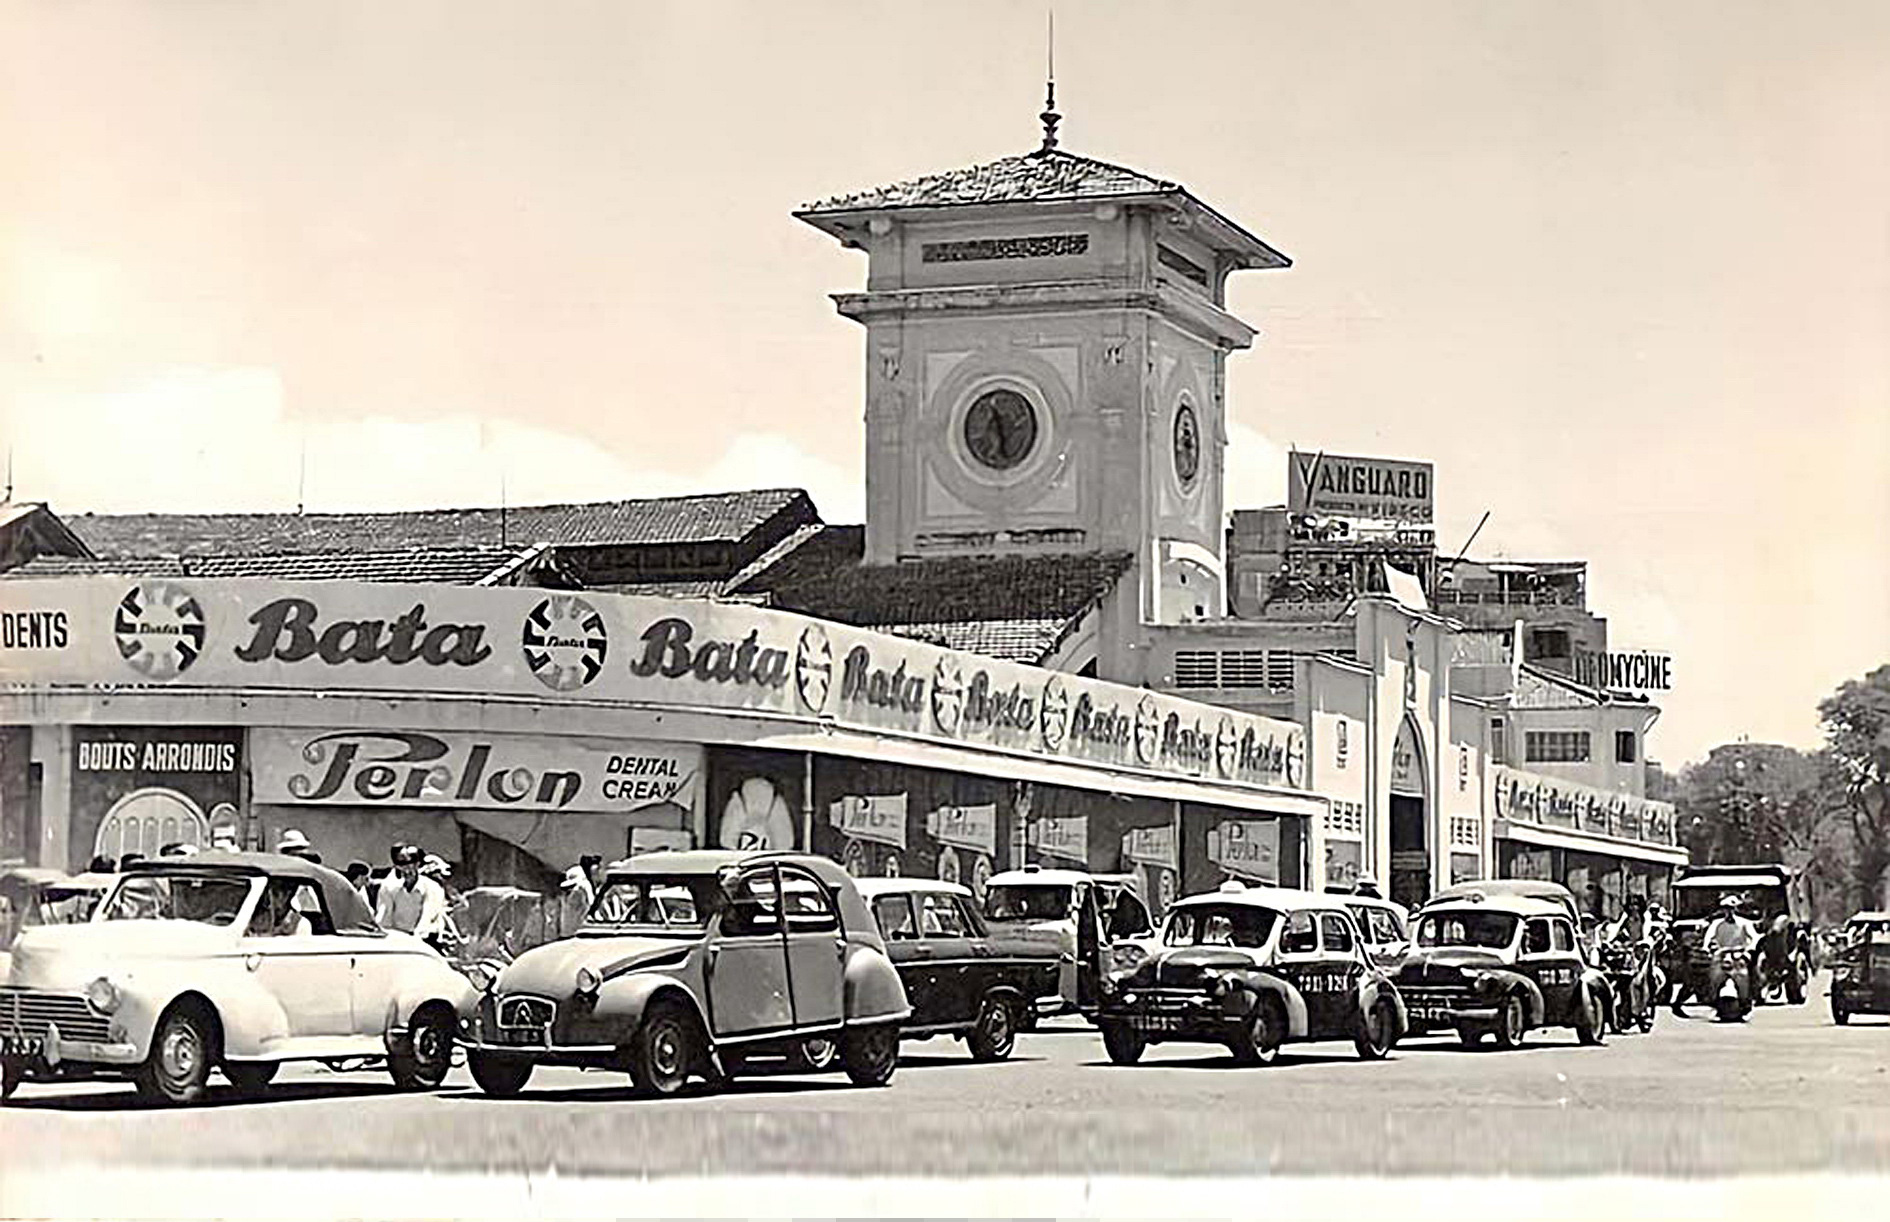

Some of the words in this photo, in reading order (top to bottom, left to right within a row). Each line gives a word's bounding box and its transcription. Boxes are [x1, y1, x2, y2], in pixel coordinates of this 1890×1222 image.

[1294, 450, 1427, 508] VANGUARD
[2, 612, 67, 648] DENTS
[234, 598, 492, 666] Bata
[630, 617, 790, 688] Bata
[842, 645, 925, 713] Bata
[78, 741, 136, 770] BOUTS
[142, 742, 236, 772] ARRONDIS
[287, 732, 581, 807] Perlon
[606, 755, 678, 777] DENTAL
